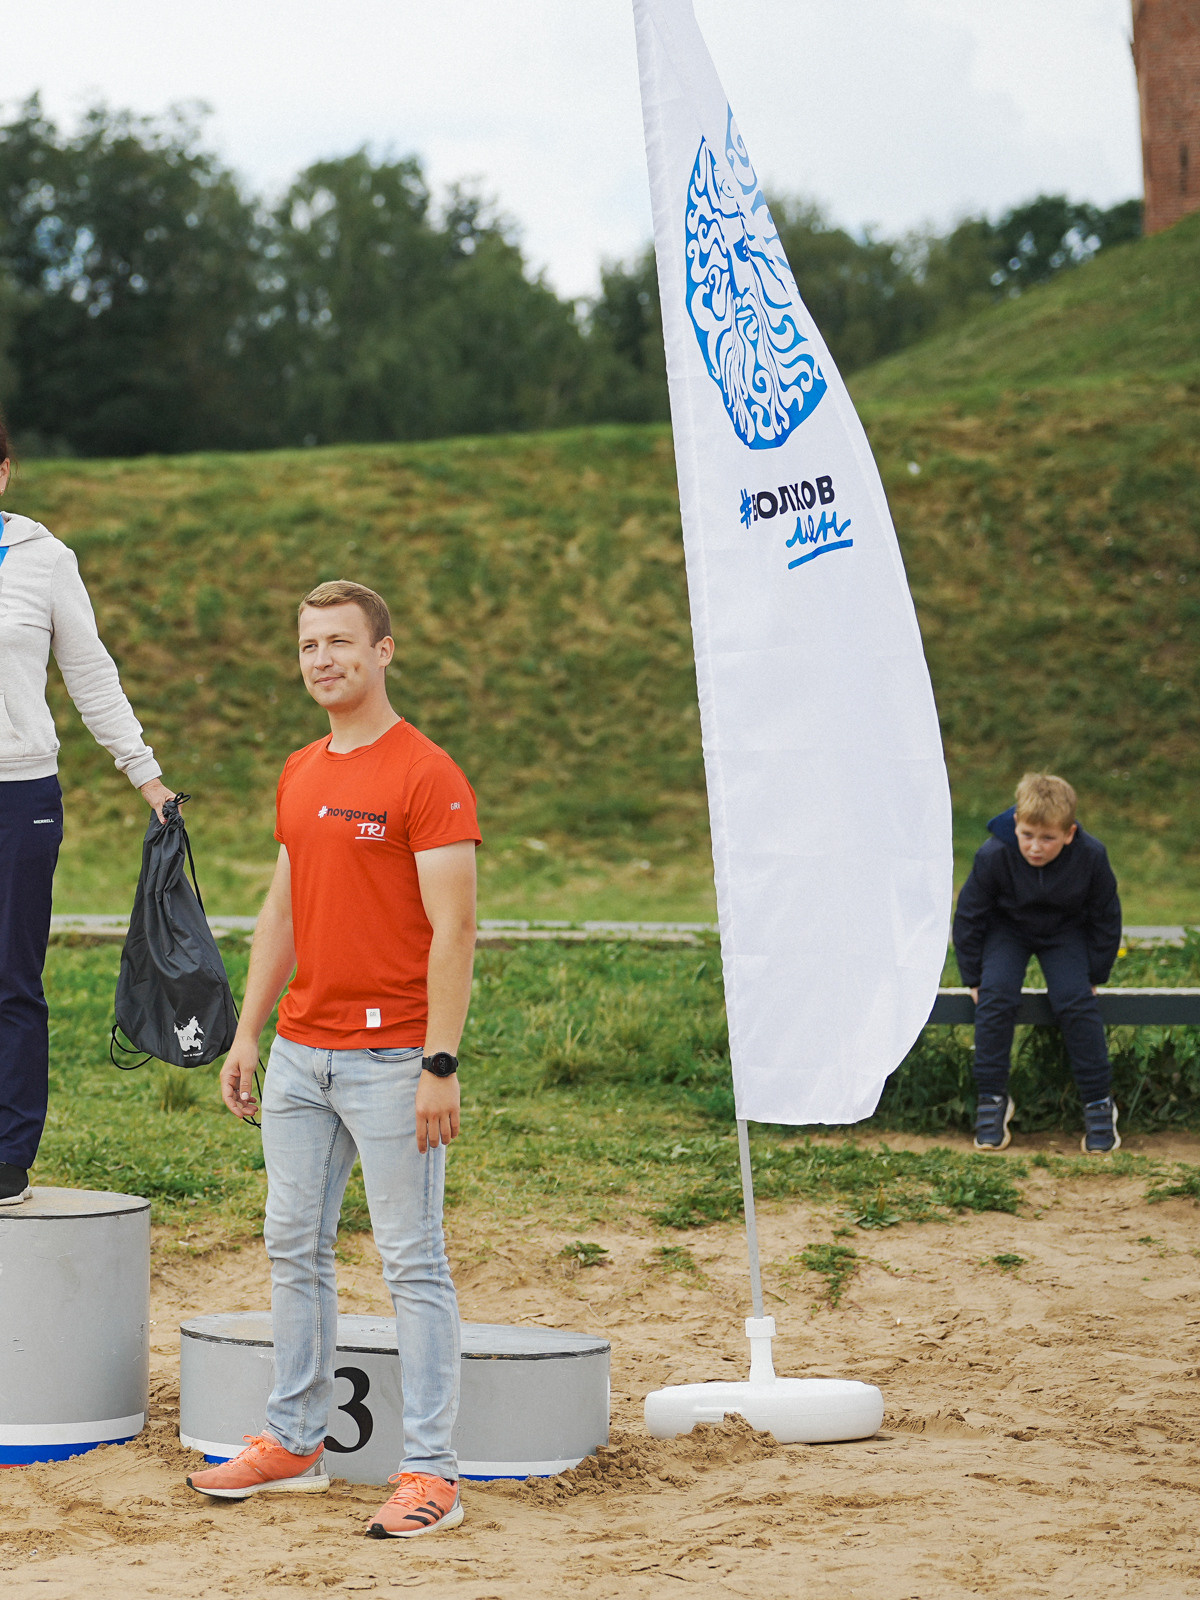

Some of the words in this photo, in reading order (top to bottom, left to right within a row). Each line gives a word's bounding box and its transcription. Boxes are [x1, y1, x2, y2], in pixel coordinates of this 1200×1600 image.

[318, 805, 388, 824] #novgorod
[356, 822, 386, 837] TRI
[324, 1366, 374, 1453] 3
